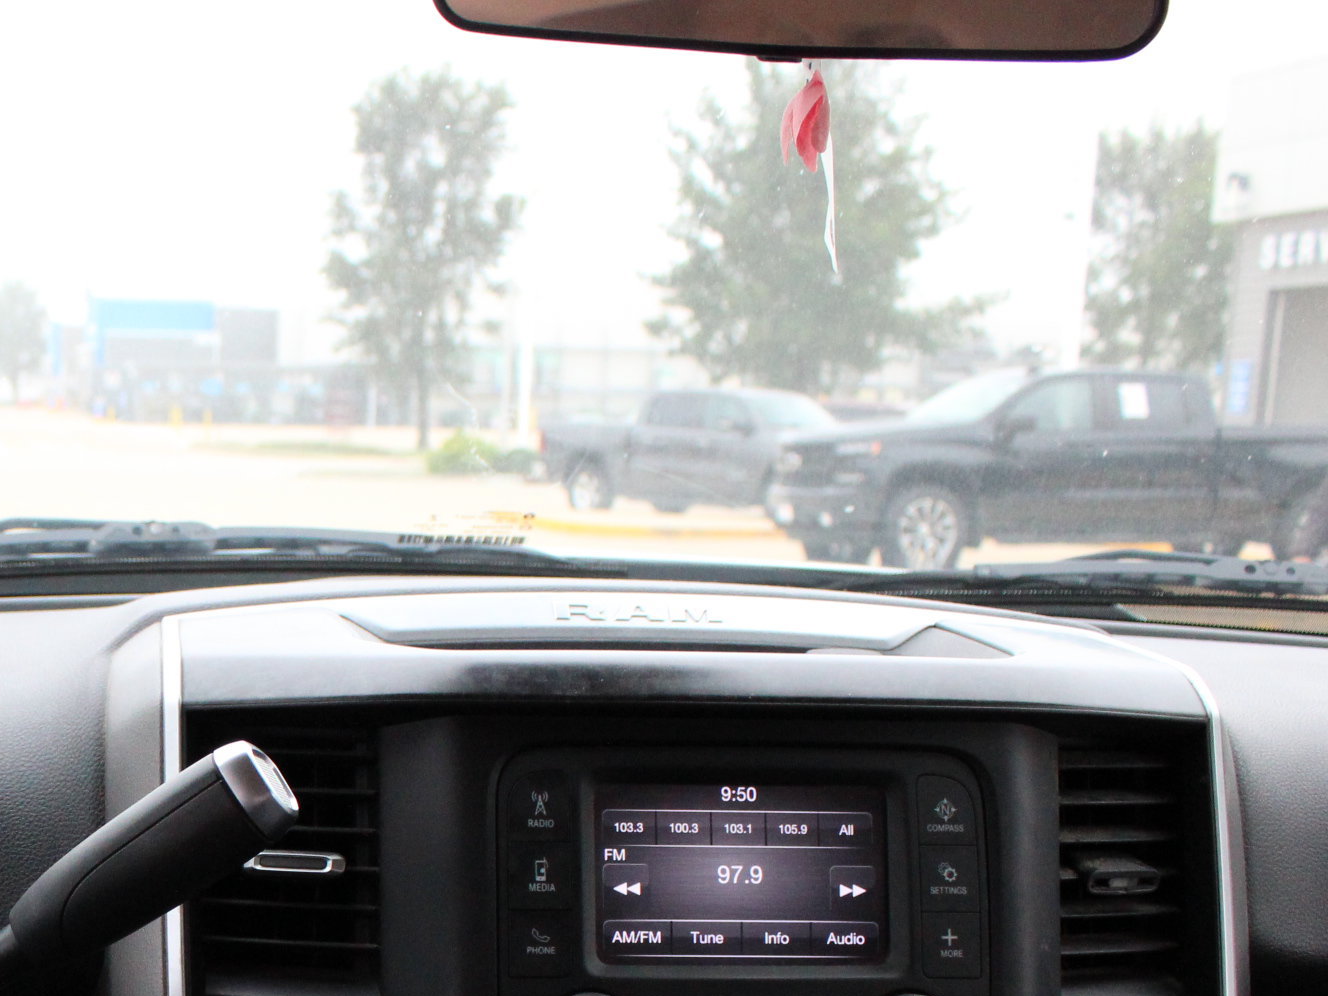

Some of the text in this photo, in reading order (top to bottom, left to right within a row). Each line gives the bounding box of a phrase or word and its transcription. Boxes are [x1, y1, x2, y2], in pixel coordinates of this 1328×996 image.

[554, 600, 723, 623] RAM
[721, 786, 757, 802] 9:50
[528, 819, 554, 828] RADIO
[614, 822, 644, 833] 103.3
[669, 823, 699, 834] 100.3
[724, 824, 752, 834] 103.1
[927, 824, 964, 833] COMPASS
[778, 824, 808, 835] 105.9
[839, 825, 854, 836] All
[604, 849, 626, 861] FM
[717, 865, 763, 885] 97.9
[529, 883, 555, 892] MEDIA
[930, 886, 968, 895] SETTINGS
[612, 931, 662, 944] AM/FM
[690, 931, 724, 944] Tune
[764, 932, 789, 945] Info
[827, 932, 865, 945] Audio
[527, 946, 556, 955] PHONE
[941, 950, 963, 958] MORE
